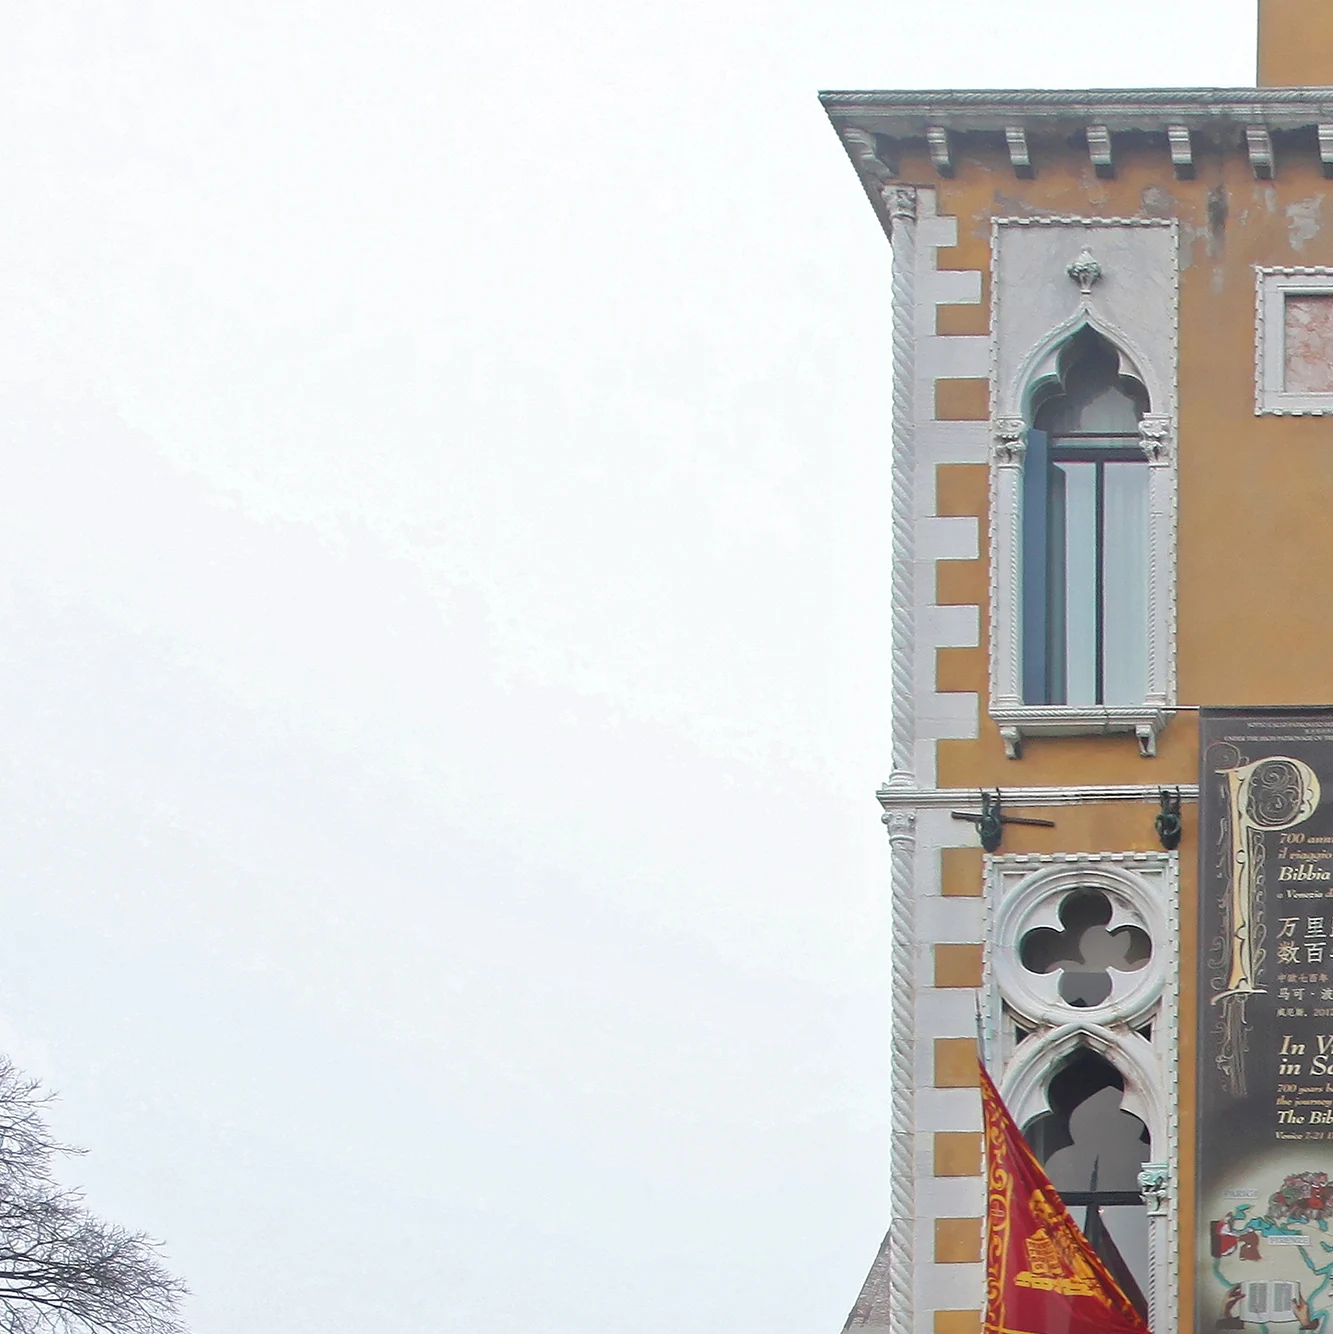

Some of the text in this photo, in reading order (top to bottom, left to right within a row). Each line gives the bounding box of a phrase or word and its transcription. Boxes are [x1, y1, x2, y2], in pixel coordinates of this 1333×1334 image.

[1280, 832, 1305, 844] 700
[1278, 864, 1331, 881] Bibbia
[1279, 1035, 1305, 1056] In
[1279, 1058, 1301, 1076] in
[1277, 1084, 1297, 1093] 700
[1277, 1109, 1305, 1125] The
